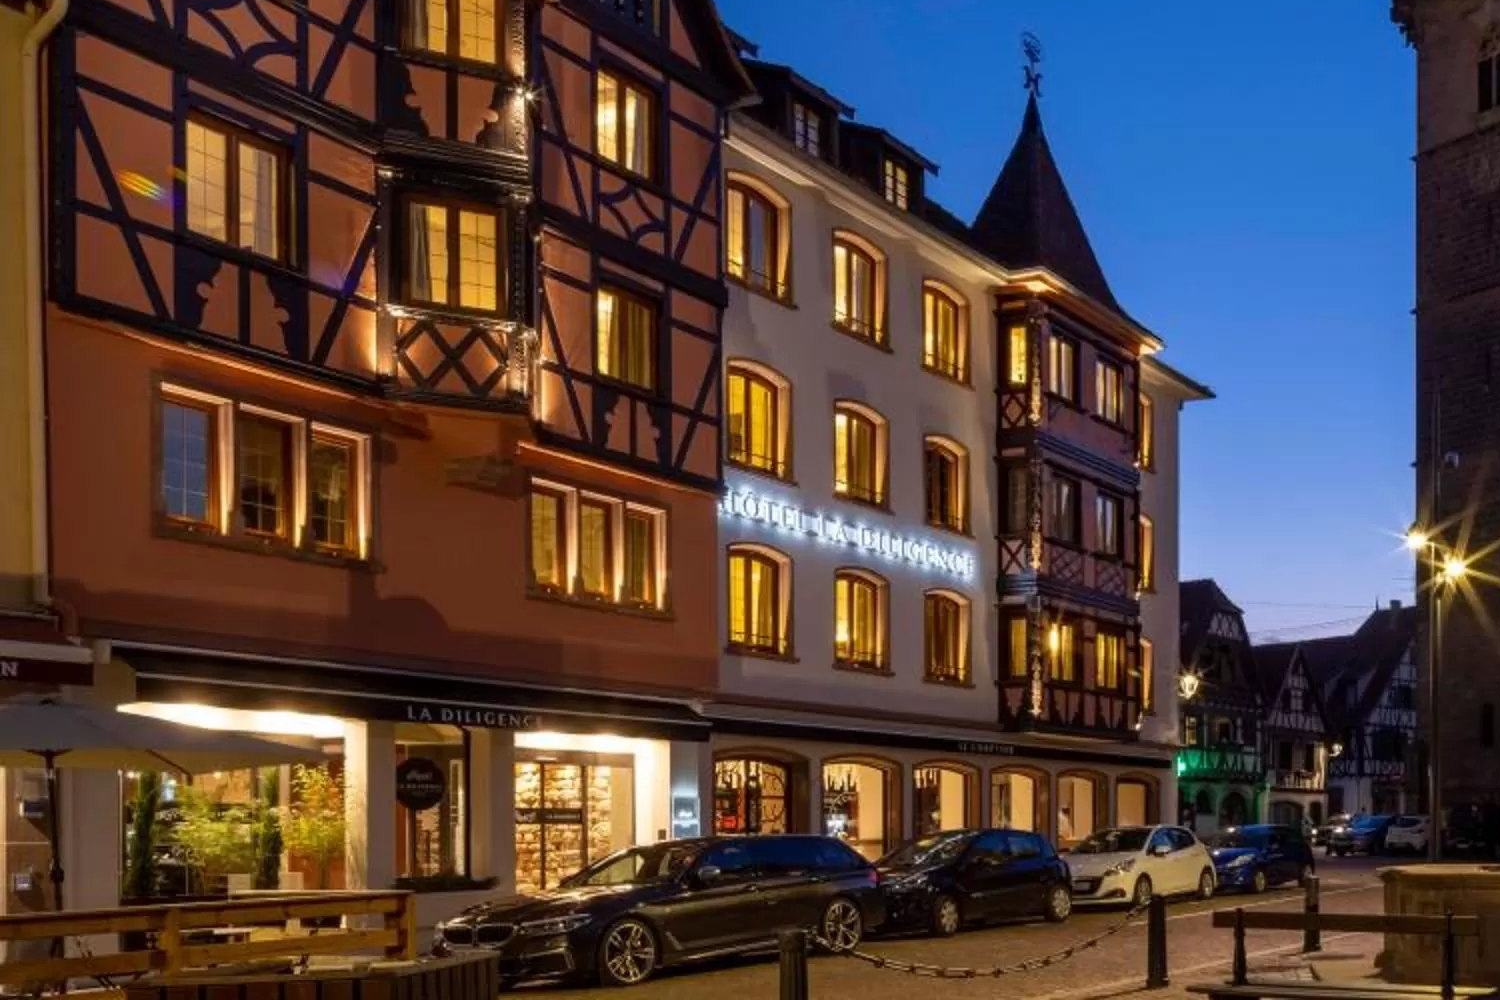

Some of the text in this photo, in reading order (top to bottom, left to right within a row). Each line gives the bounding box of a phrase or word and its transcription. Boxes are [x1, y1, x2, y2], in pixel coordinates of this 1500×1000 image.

[719, 487, 977, 578] HÔTEL LA DILIGENCE
[407, 704, 432, 721] LA
